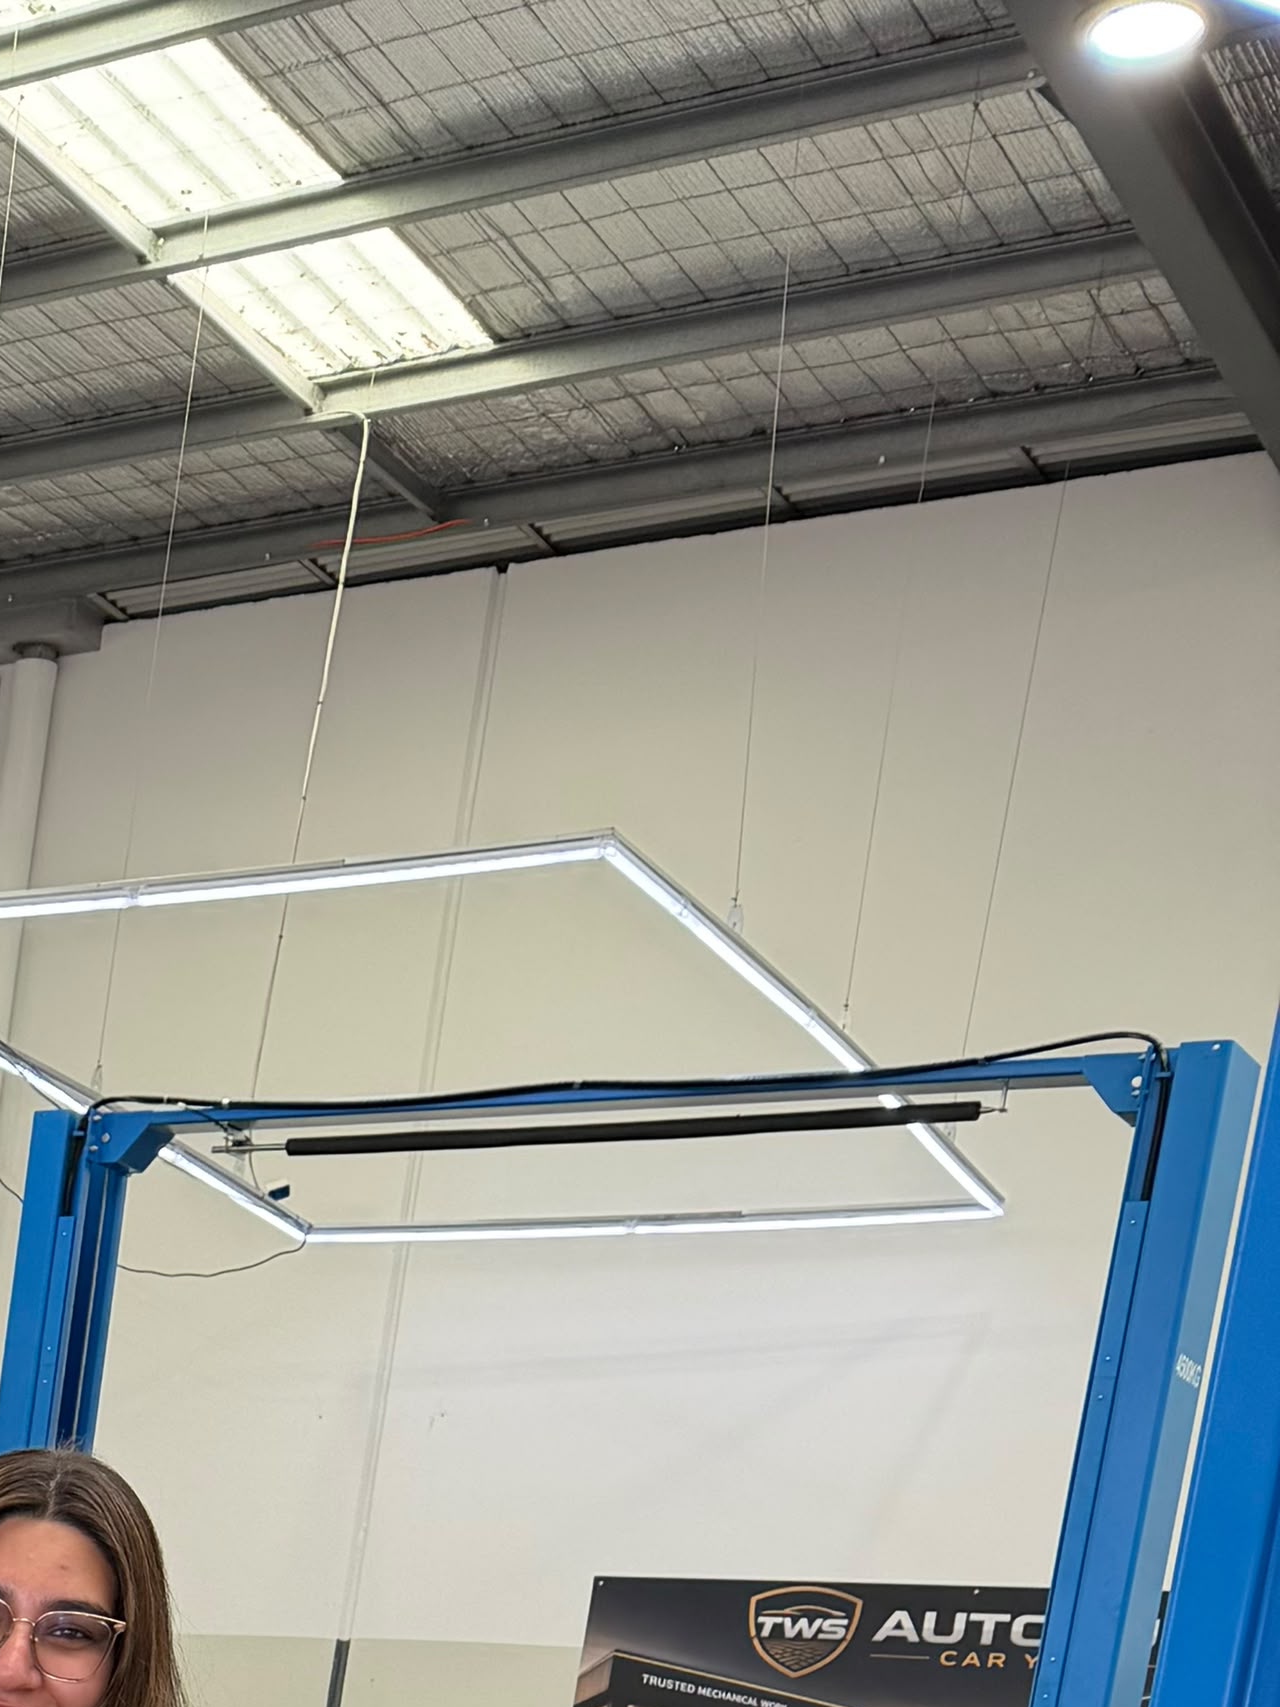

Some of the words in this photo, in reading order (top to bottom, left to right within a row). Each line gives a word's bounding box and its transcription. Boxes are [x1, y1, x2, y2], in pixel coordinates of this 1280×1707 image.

[757, 1616, 849, 1639] TWS
[940, 1651, 1006, 1668] CAR
[642, 1673, 696, 1694] TRUSTED
[697, 1685, 758, 1707] MECHANICAL
